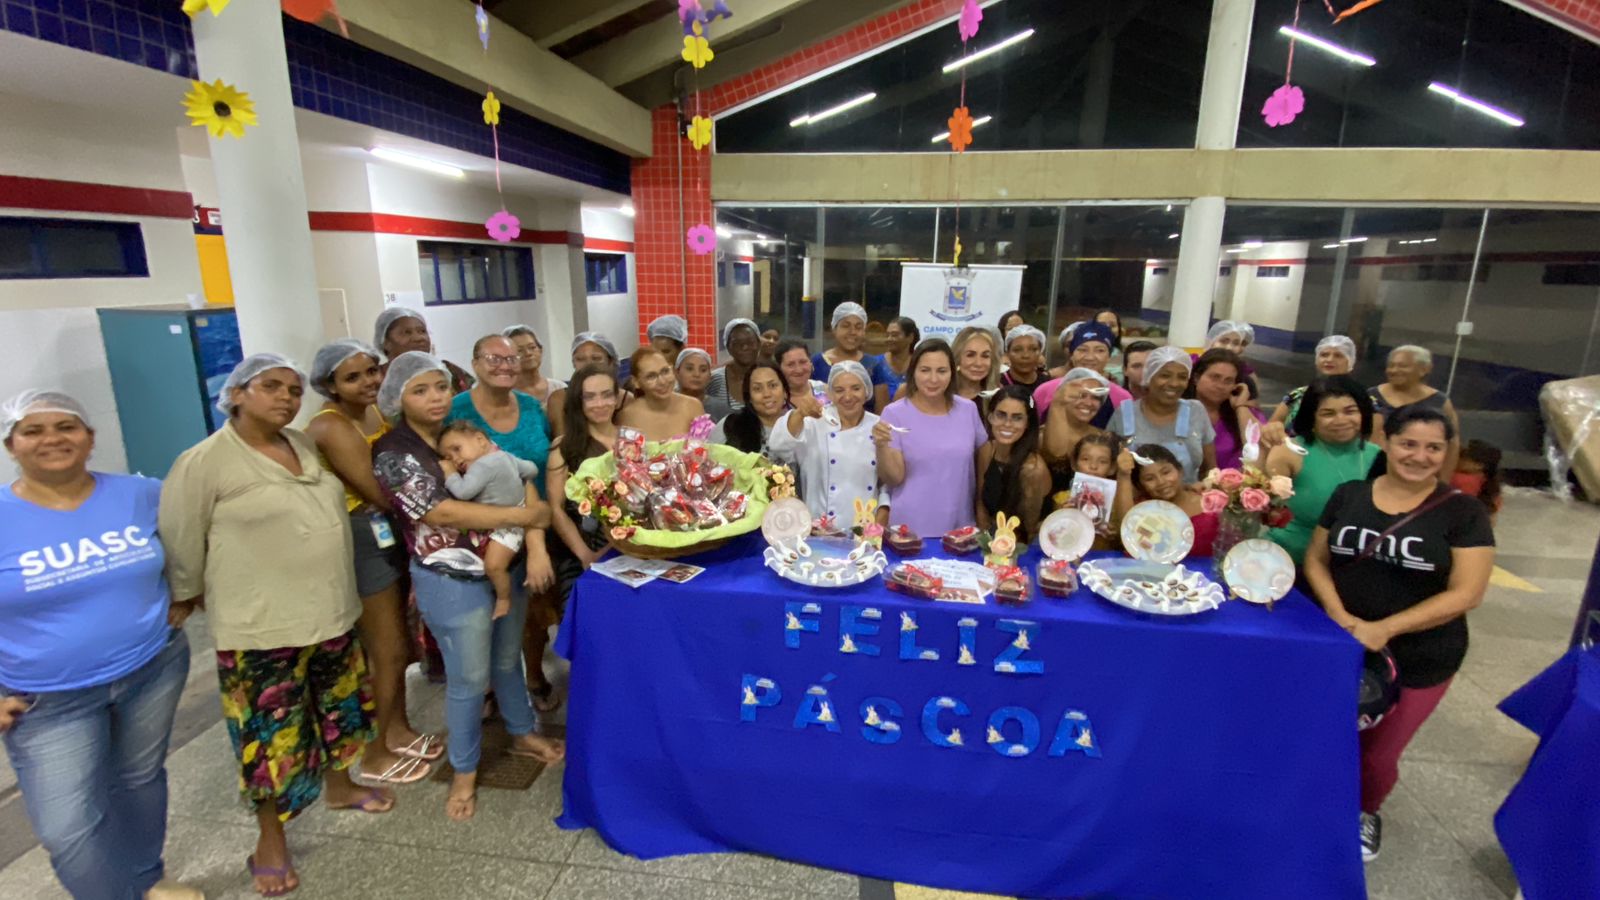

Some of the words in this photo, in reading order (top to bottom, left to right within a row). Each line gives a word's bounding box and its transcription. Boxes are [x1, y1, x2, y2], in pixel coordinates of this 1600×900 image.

[923, 326, 954, 334] CAMPO
[19, 525, 149, 576] SUASC
[784, 601, 1044, 674] FELIZ
[740, 672, 1103, 758] PÁSCOA
